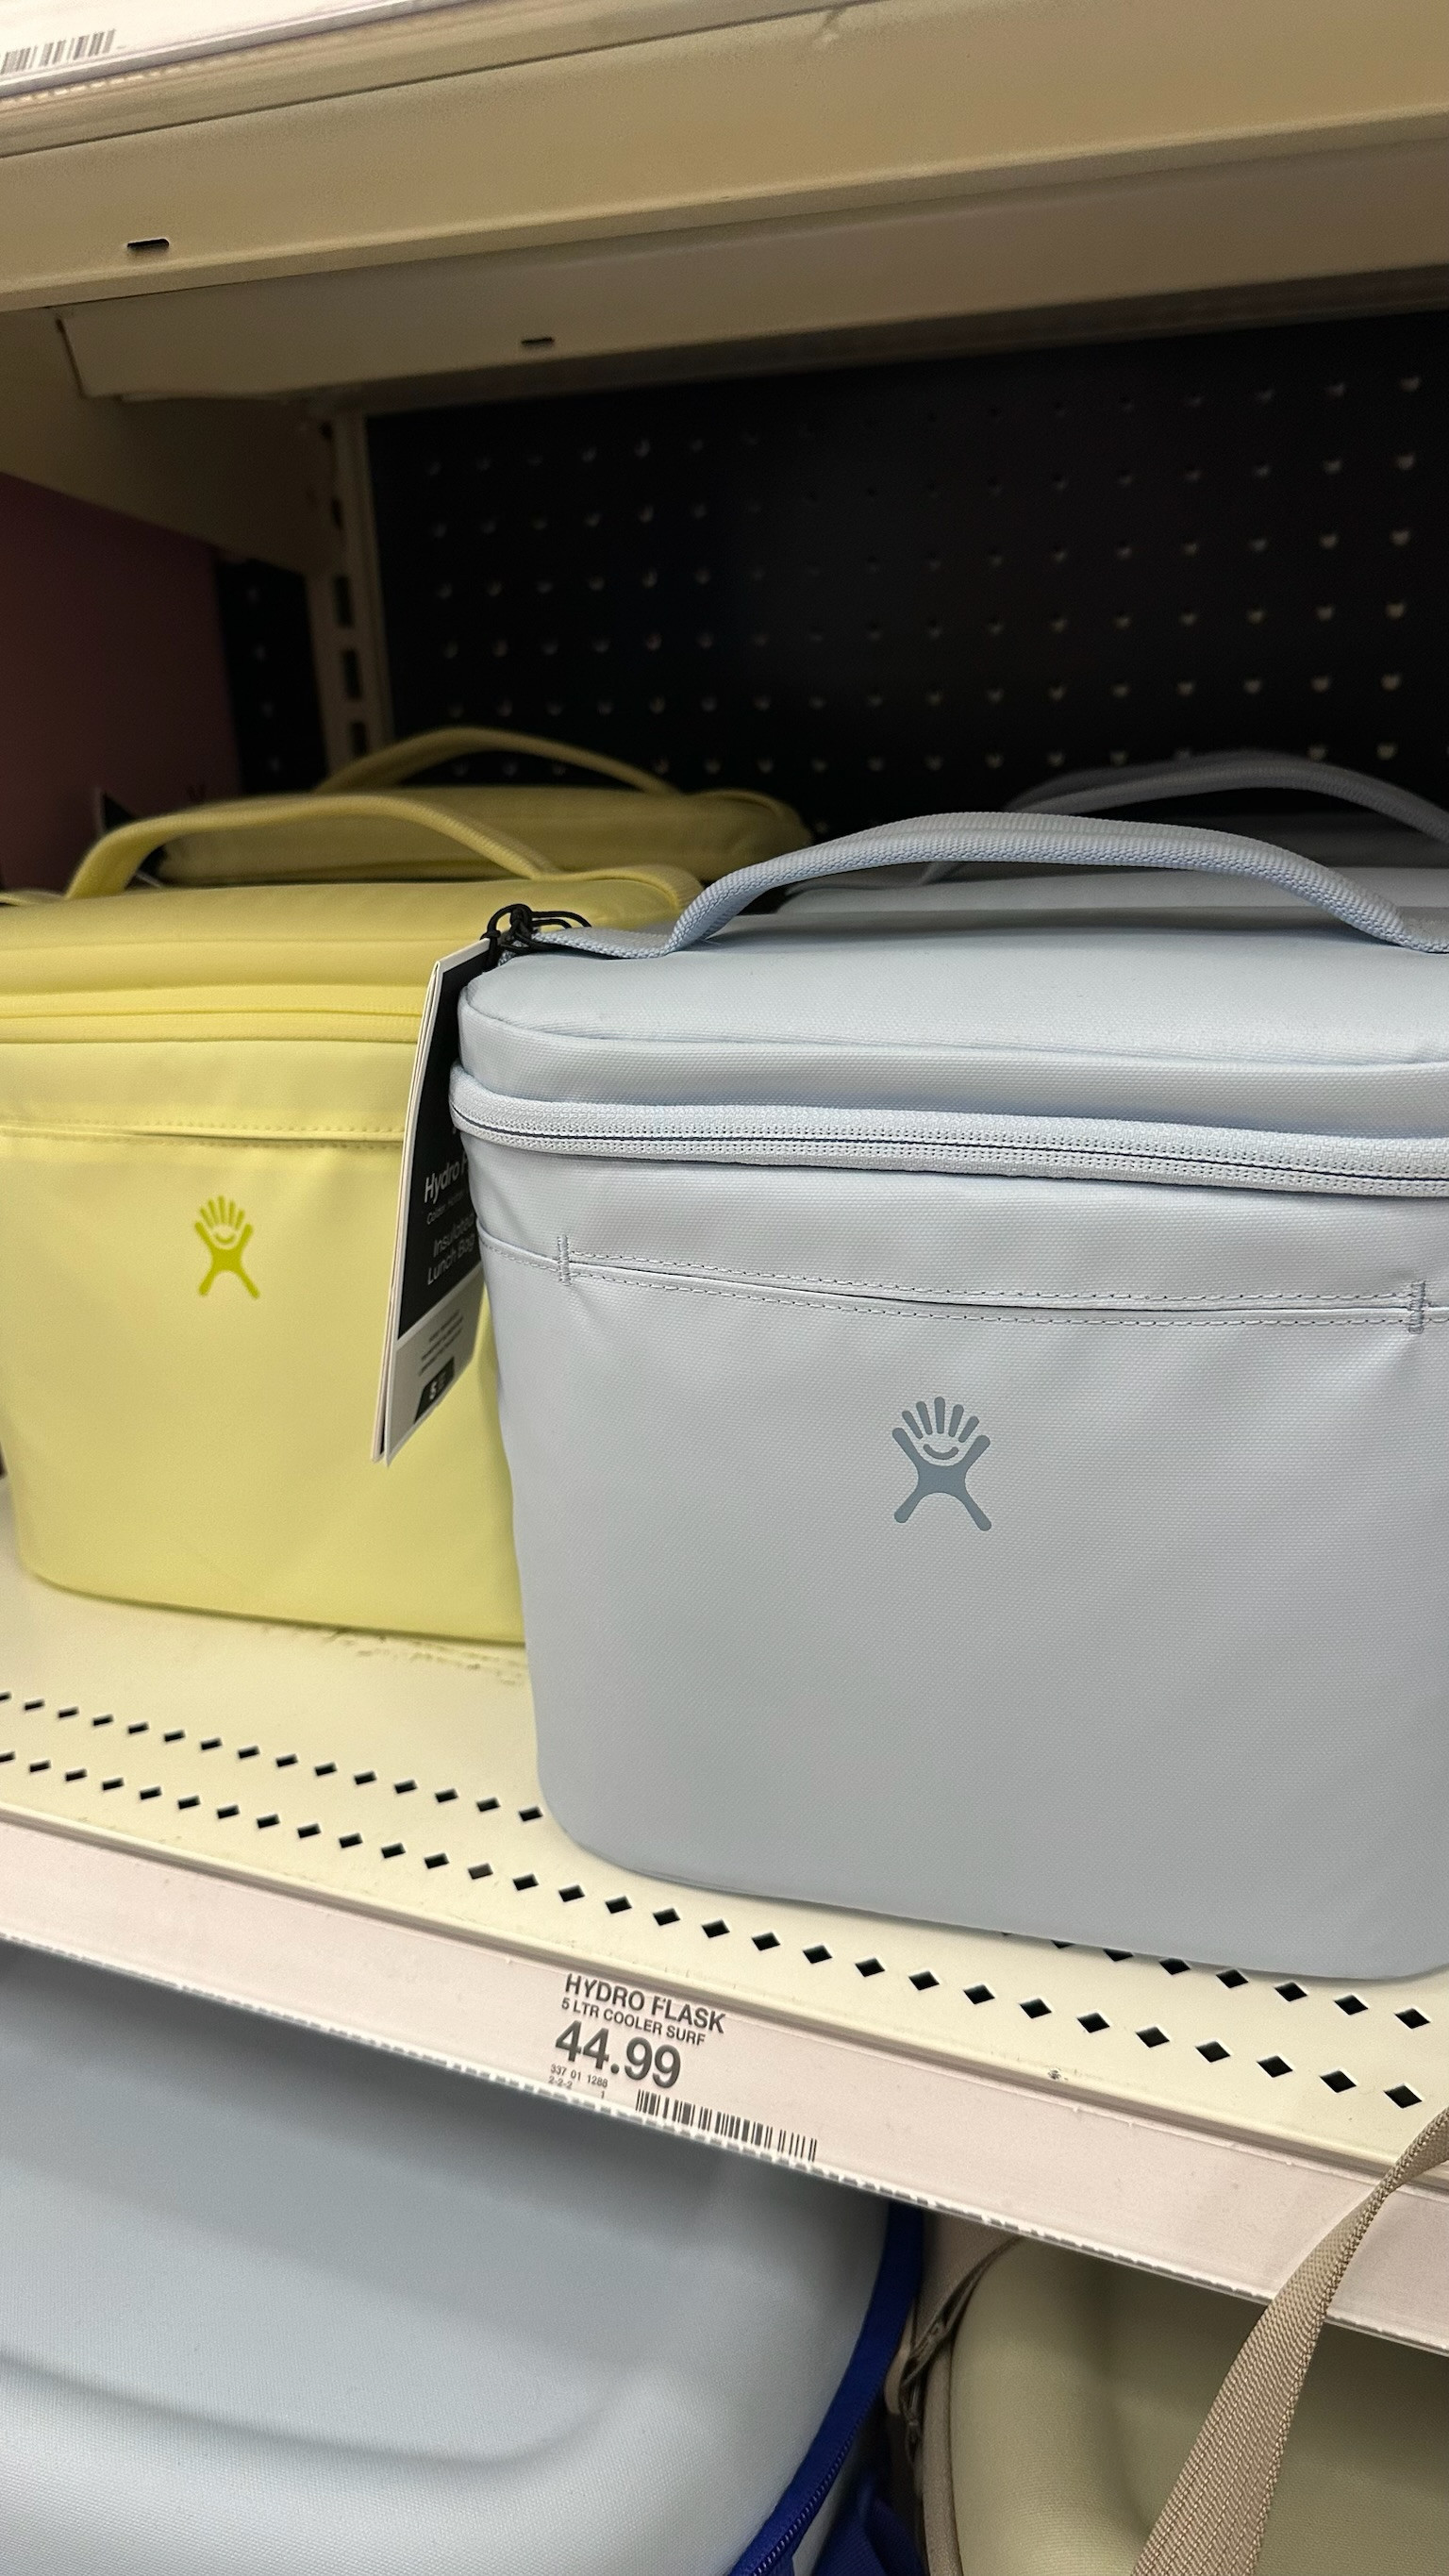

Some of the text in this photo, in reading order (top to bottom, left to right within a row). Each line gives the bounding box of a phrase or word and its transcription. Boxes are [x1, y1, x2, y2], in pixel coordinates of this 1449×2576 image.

[425, 1161, 459, 1204] Hydro
[427, 1246, 456, 1285] Lunch
[561, 1997, 707, 2046] 5 LTR COOLER SURF
[565, 1973, 726, 2033] HYDRO FLASK
[555, 2019, 681, 2089] 44.99
[548, 2076, 574, 2090] 2-2-2
[550, 2064, 608, 2088] 337 01 1288
